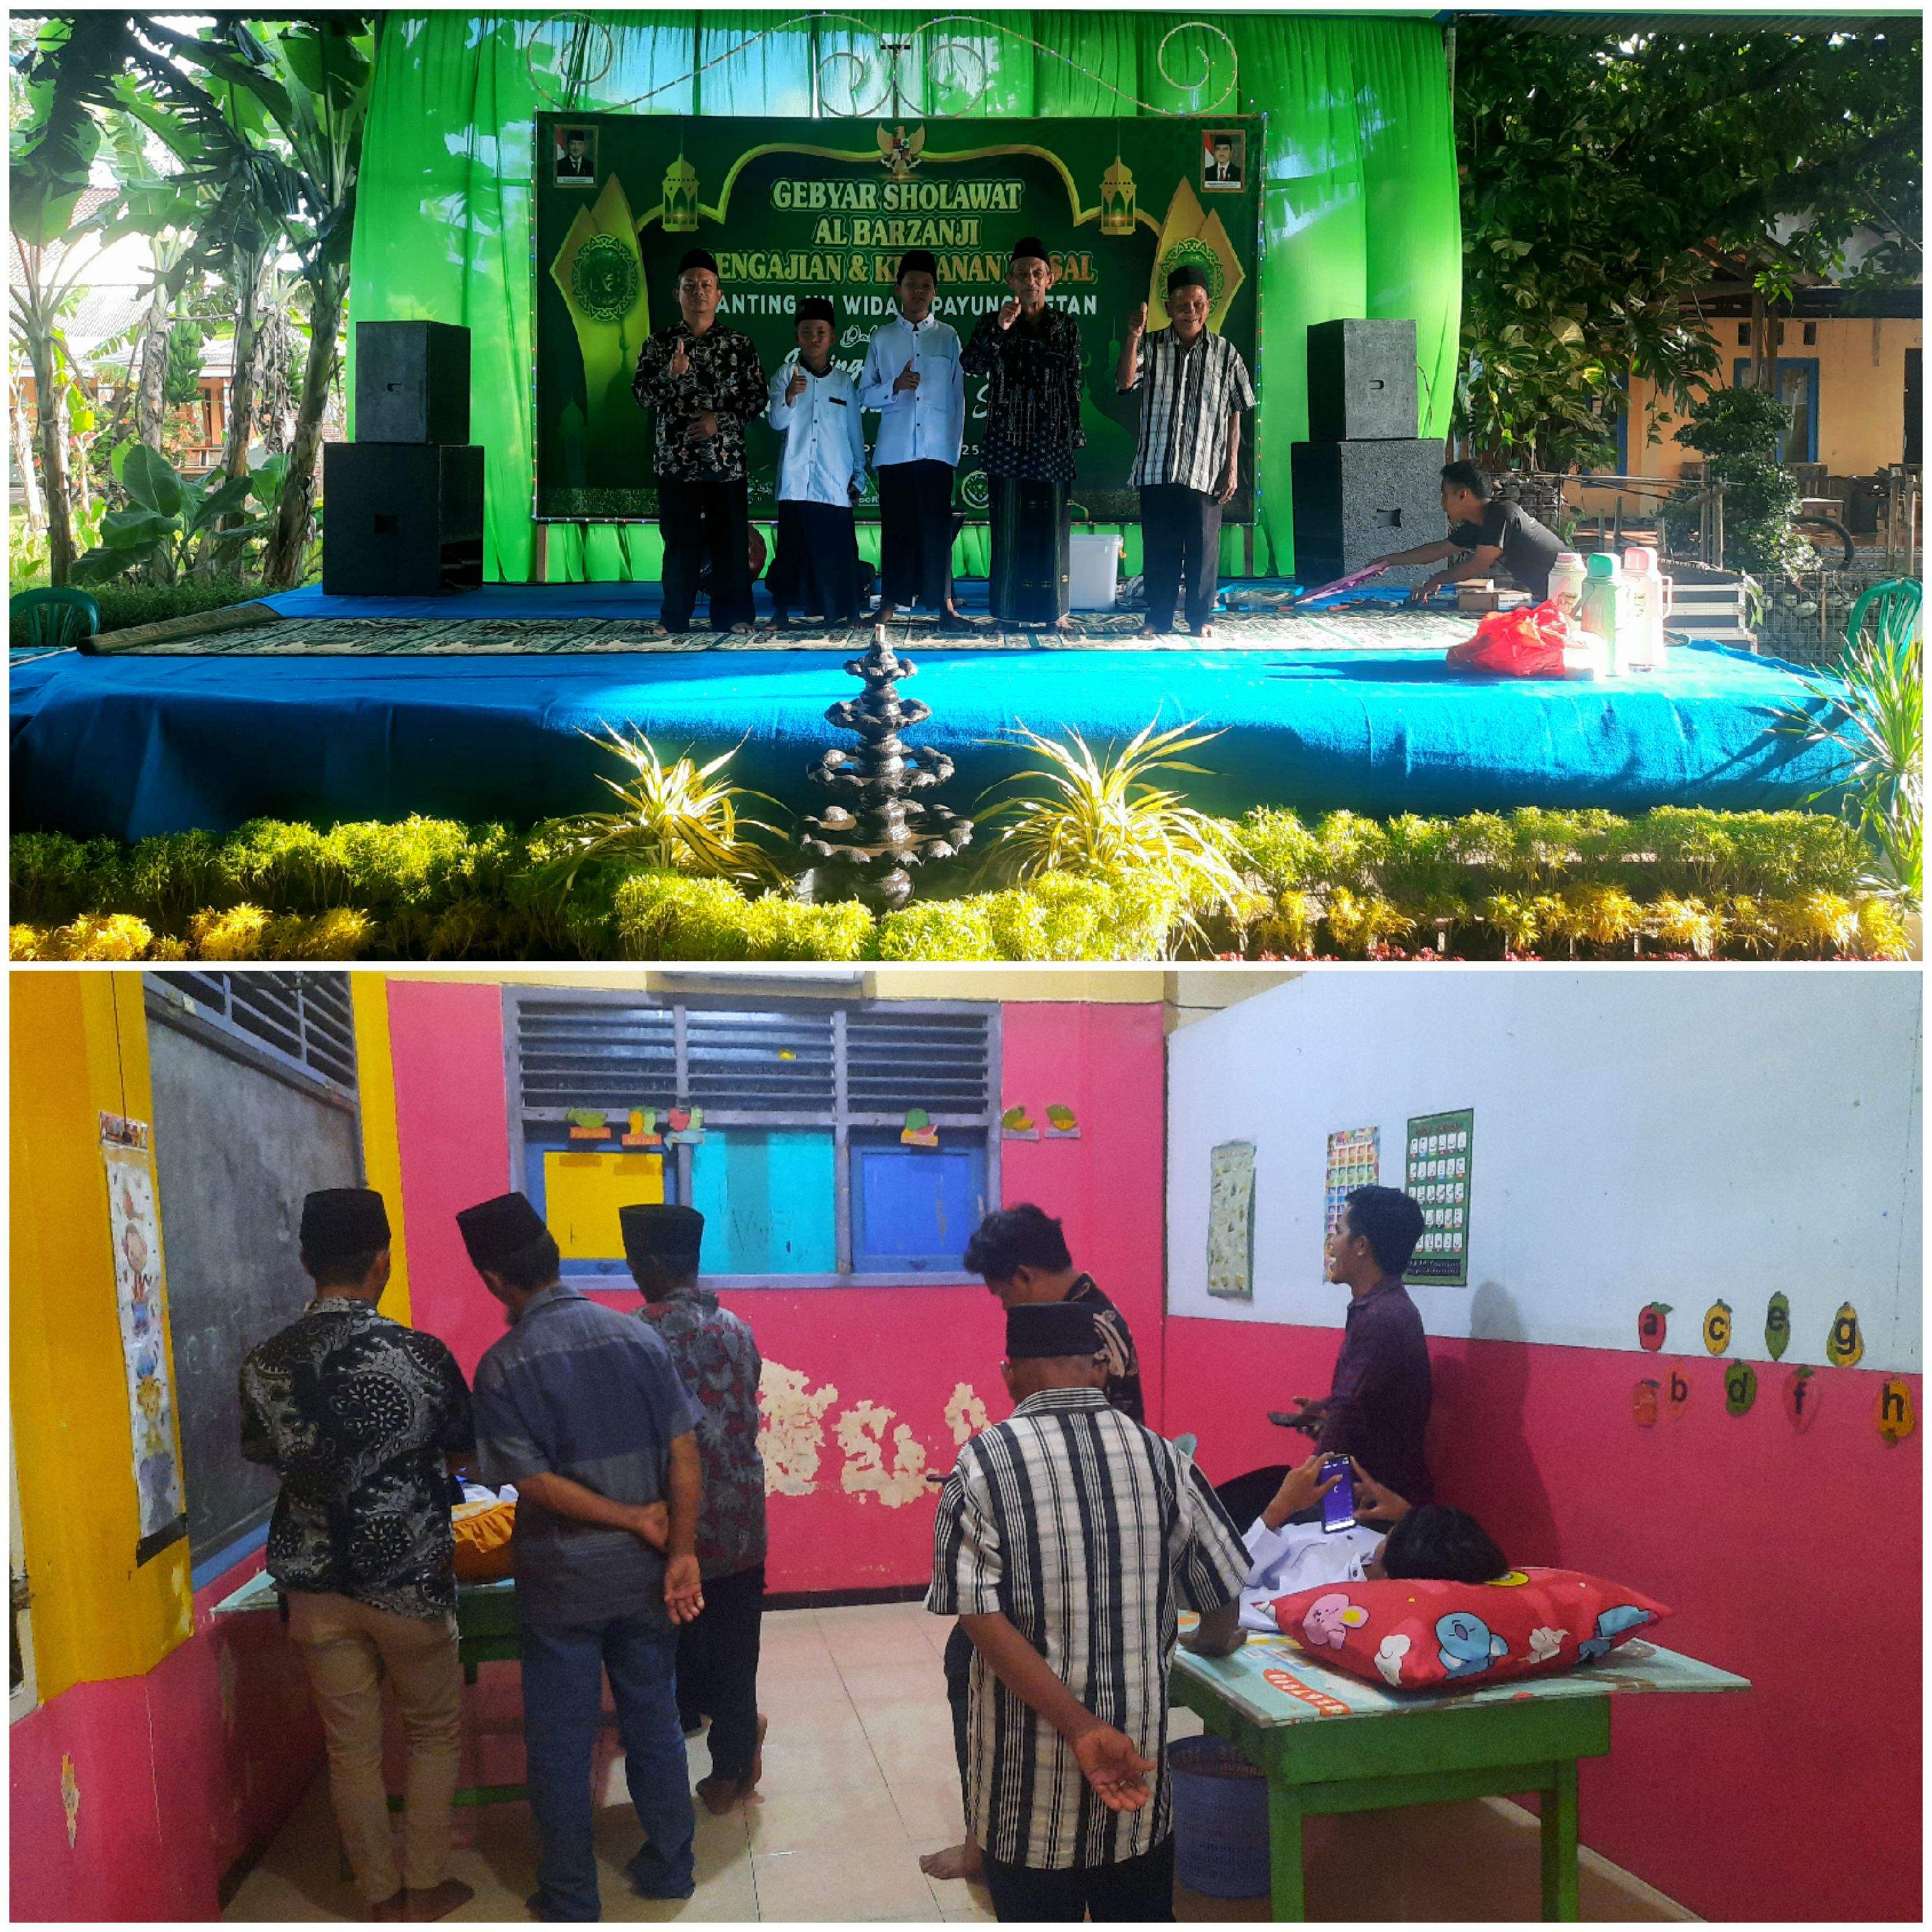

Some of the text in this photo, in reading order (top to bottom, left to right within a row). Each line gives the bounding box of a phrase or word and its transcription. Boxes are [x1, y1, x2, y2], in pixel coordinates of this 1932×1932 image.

[773, 180, 1022, 210] GEBYAR SHOLAWAT
[814, 218, 979, 246] AL BARZANJI
[714, 252, 842, 280] ENGAJIAN
[848, 254, 869, 281] &
[875, 255, 1002, 282] KANAN
[715, 294, 796, 315] ANTING
[1044, 294, 1097, 315] ETAN
[1644, 1313, 1658, 1336] a
[1709, 1316, 1725, 1340] c
[1767, 1305, 1786, 1330] e
[1835, 1317, 1856, 1355] g
[1671, 1371, 1688, 1403] b
[1728, 1372, 1750, 1403] d
[1794, 1381, 1807, 1415] f
[1882, 1383, 1904, 1422] h
